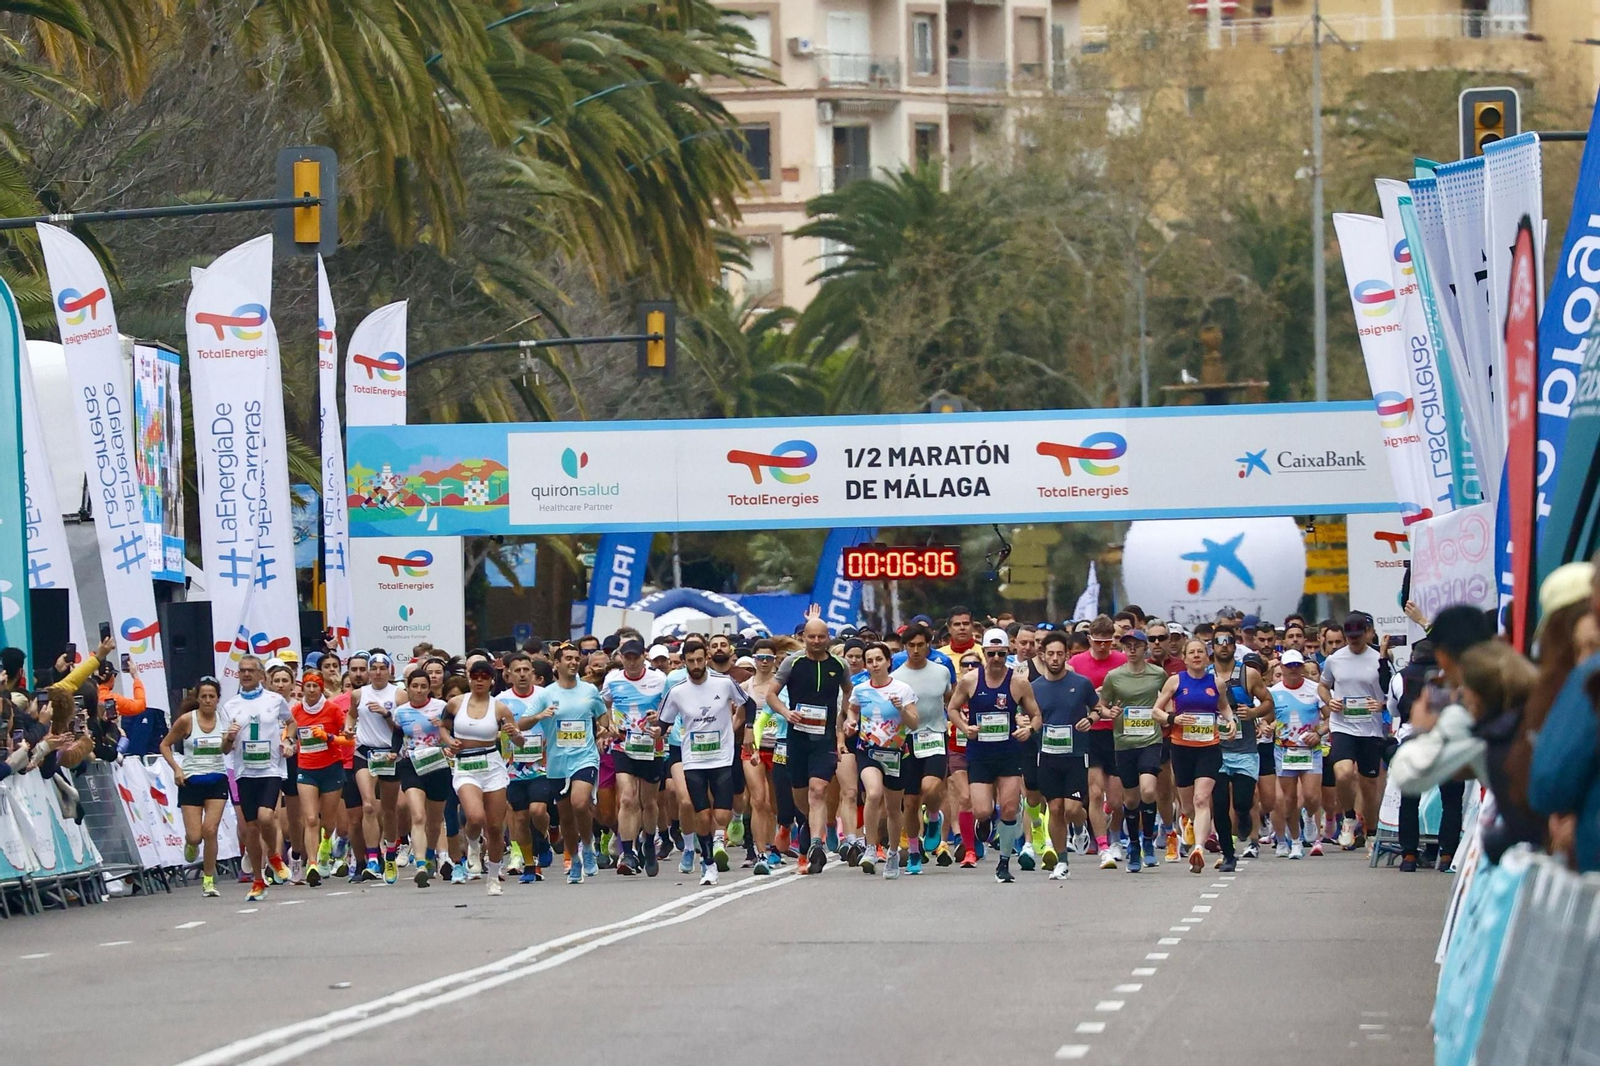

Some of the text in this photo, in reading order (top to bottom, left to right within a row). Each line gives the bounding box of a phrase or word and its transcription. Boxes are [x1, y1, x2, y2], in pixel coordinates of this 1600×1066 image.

[353, 385, 407, 398] TotalEnergies
[844, 439, 1010, 469] 1/2 MARATÓN
[1276, 449, 1367, 469] CaixaBank
[845, 474, 991, 501] DE MÁLAGA
[1037, 485, 1129, 499] TotalEnergies
[728, 492, 819, 507] TotalEnergies
[539, 502, 613, 513] Healthcare Partner
[848, 551, 956, 577] 00:06:06
[378, 582, 434, 591] TotalEnergies
[1130, 719, 1150, 728] 2650
[1190, 725, 1210, 734] 3470
[563, 732, 582, 740] 2143
